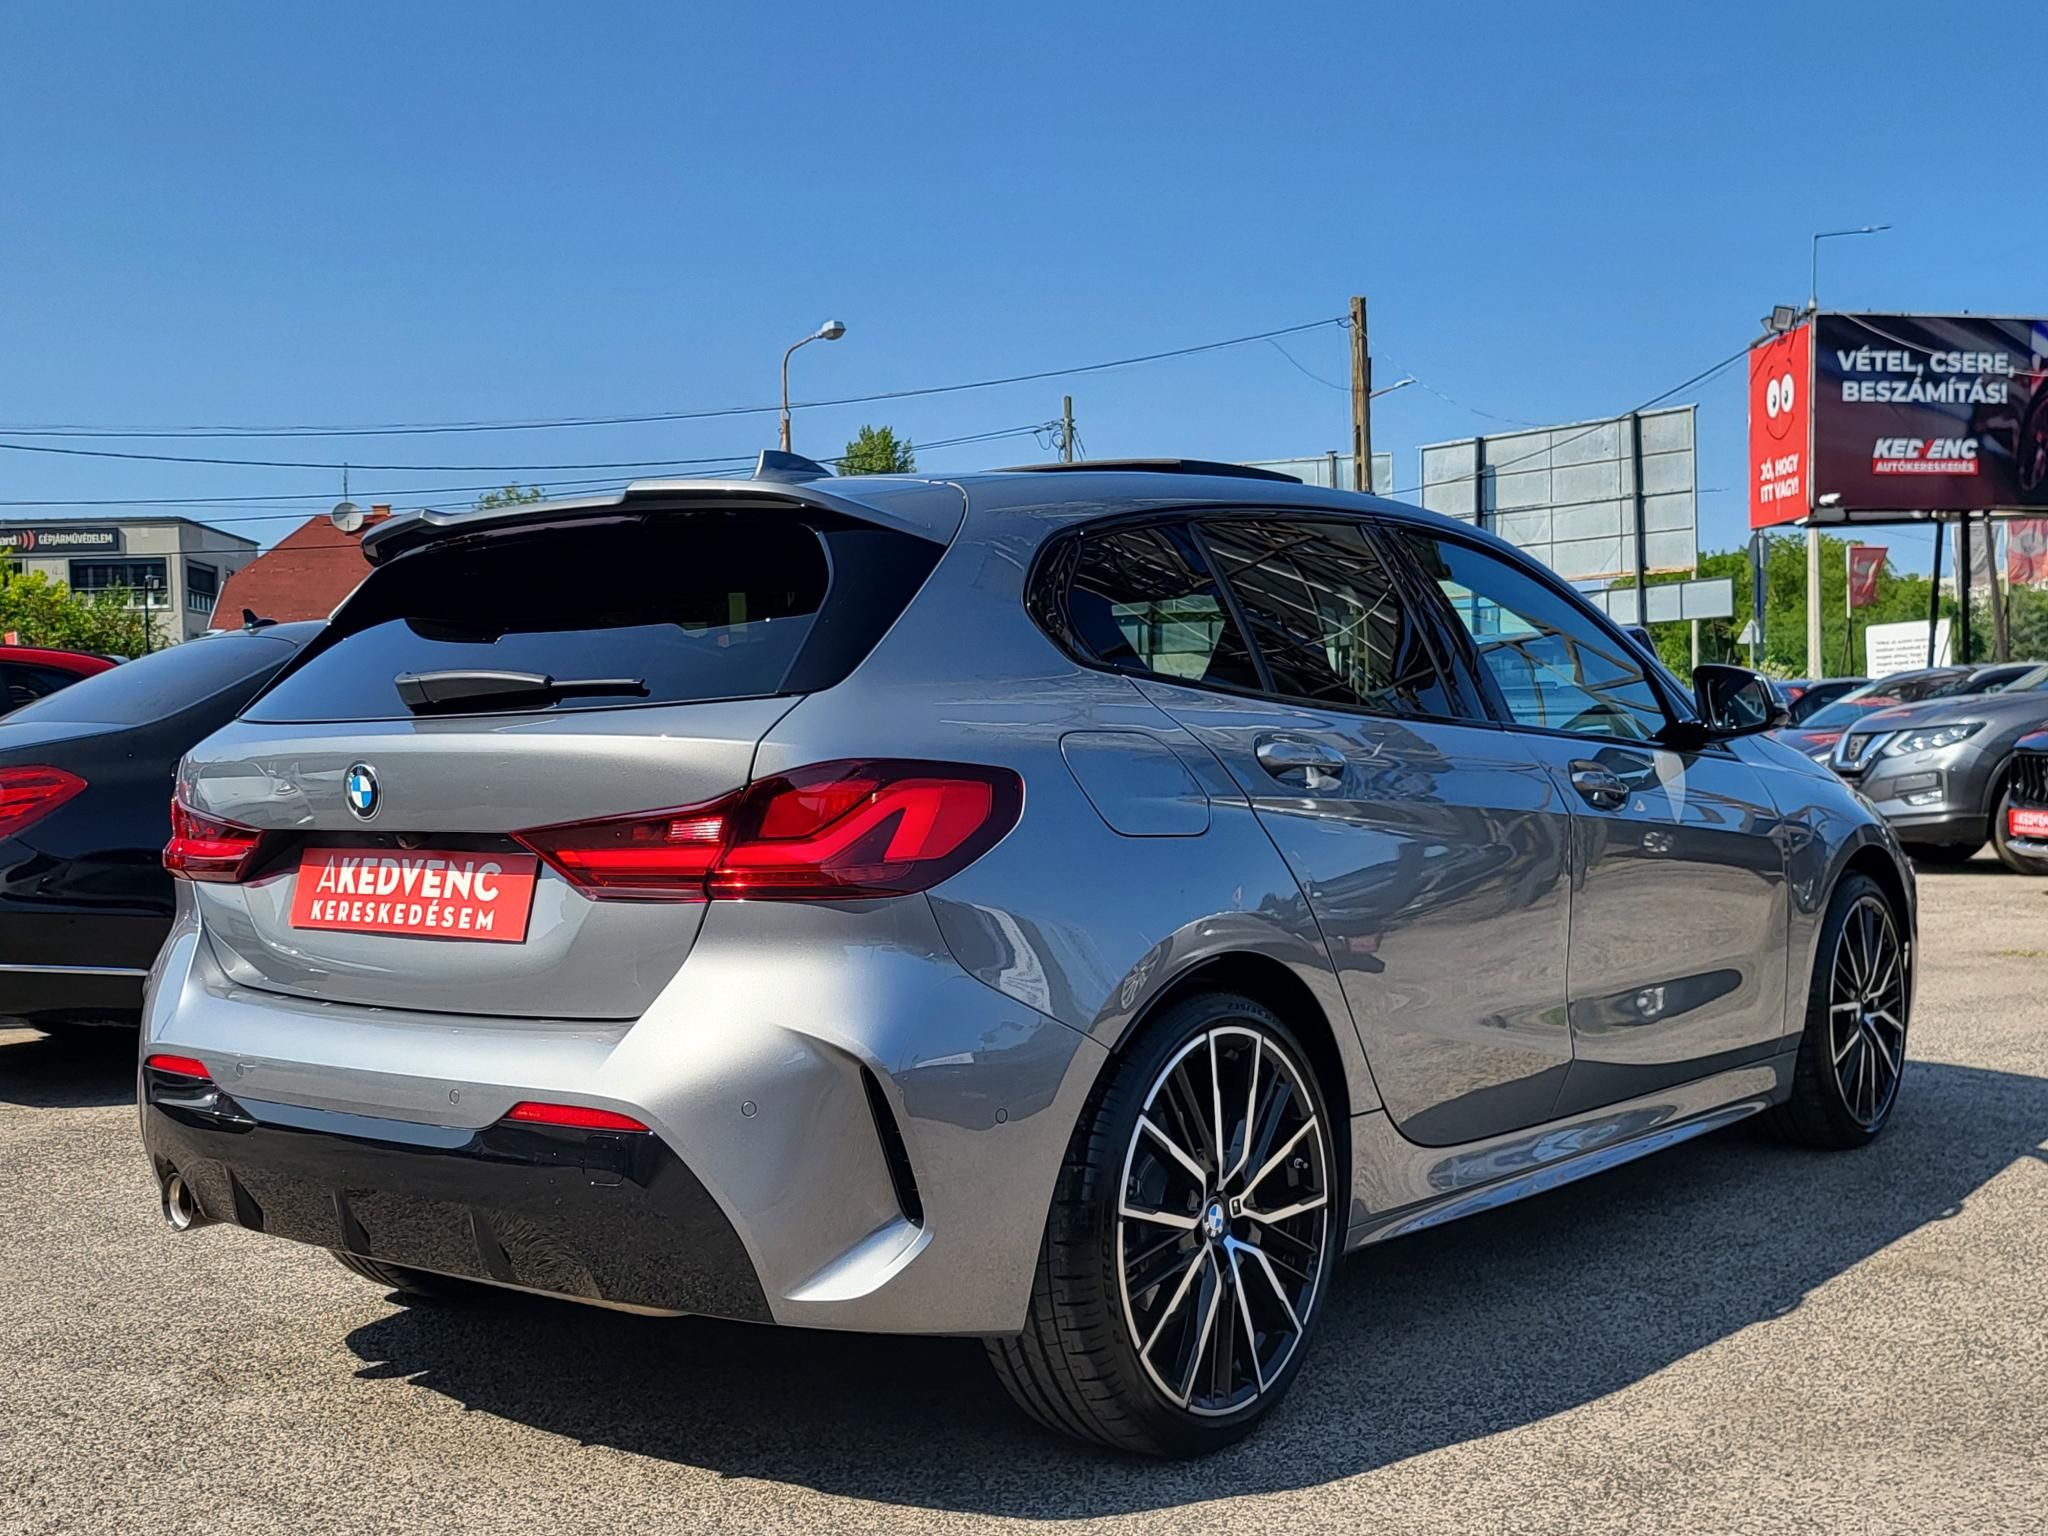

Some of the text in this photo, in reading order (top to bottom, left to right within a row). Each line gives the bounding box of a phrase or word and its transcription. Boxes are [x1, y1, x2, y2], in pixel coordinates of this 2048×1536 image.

[1837, 345, 2015, 377] VÉTEL, CSERE,
[1841, 376, 2008, 404] BESZÁMÍTÁS!
[1872, 437, 1979, 459] KEDVENC
[1775, 452, 1799, 477] HOGY
[1876, 459, 1975, 473] AUTÓKERESKEDÉS
[1760, 483, 1774, 503] ITT
[310, 899, 495, 931] KERESKEDÉSEM
